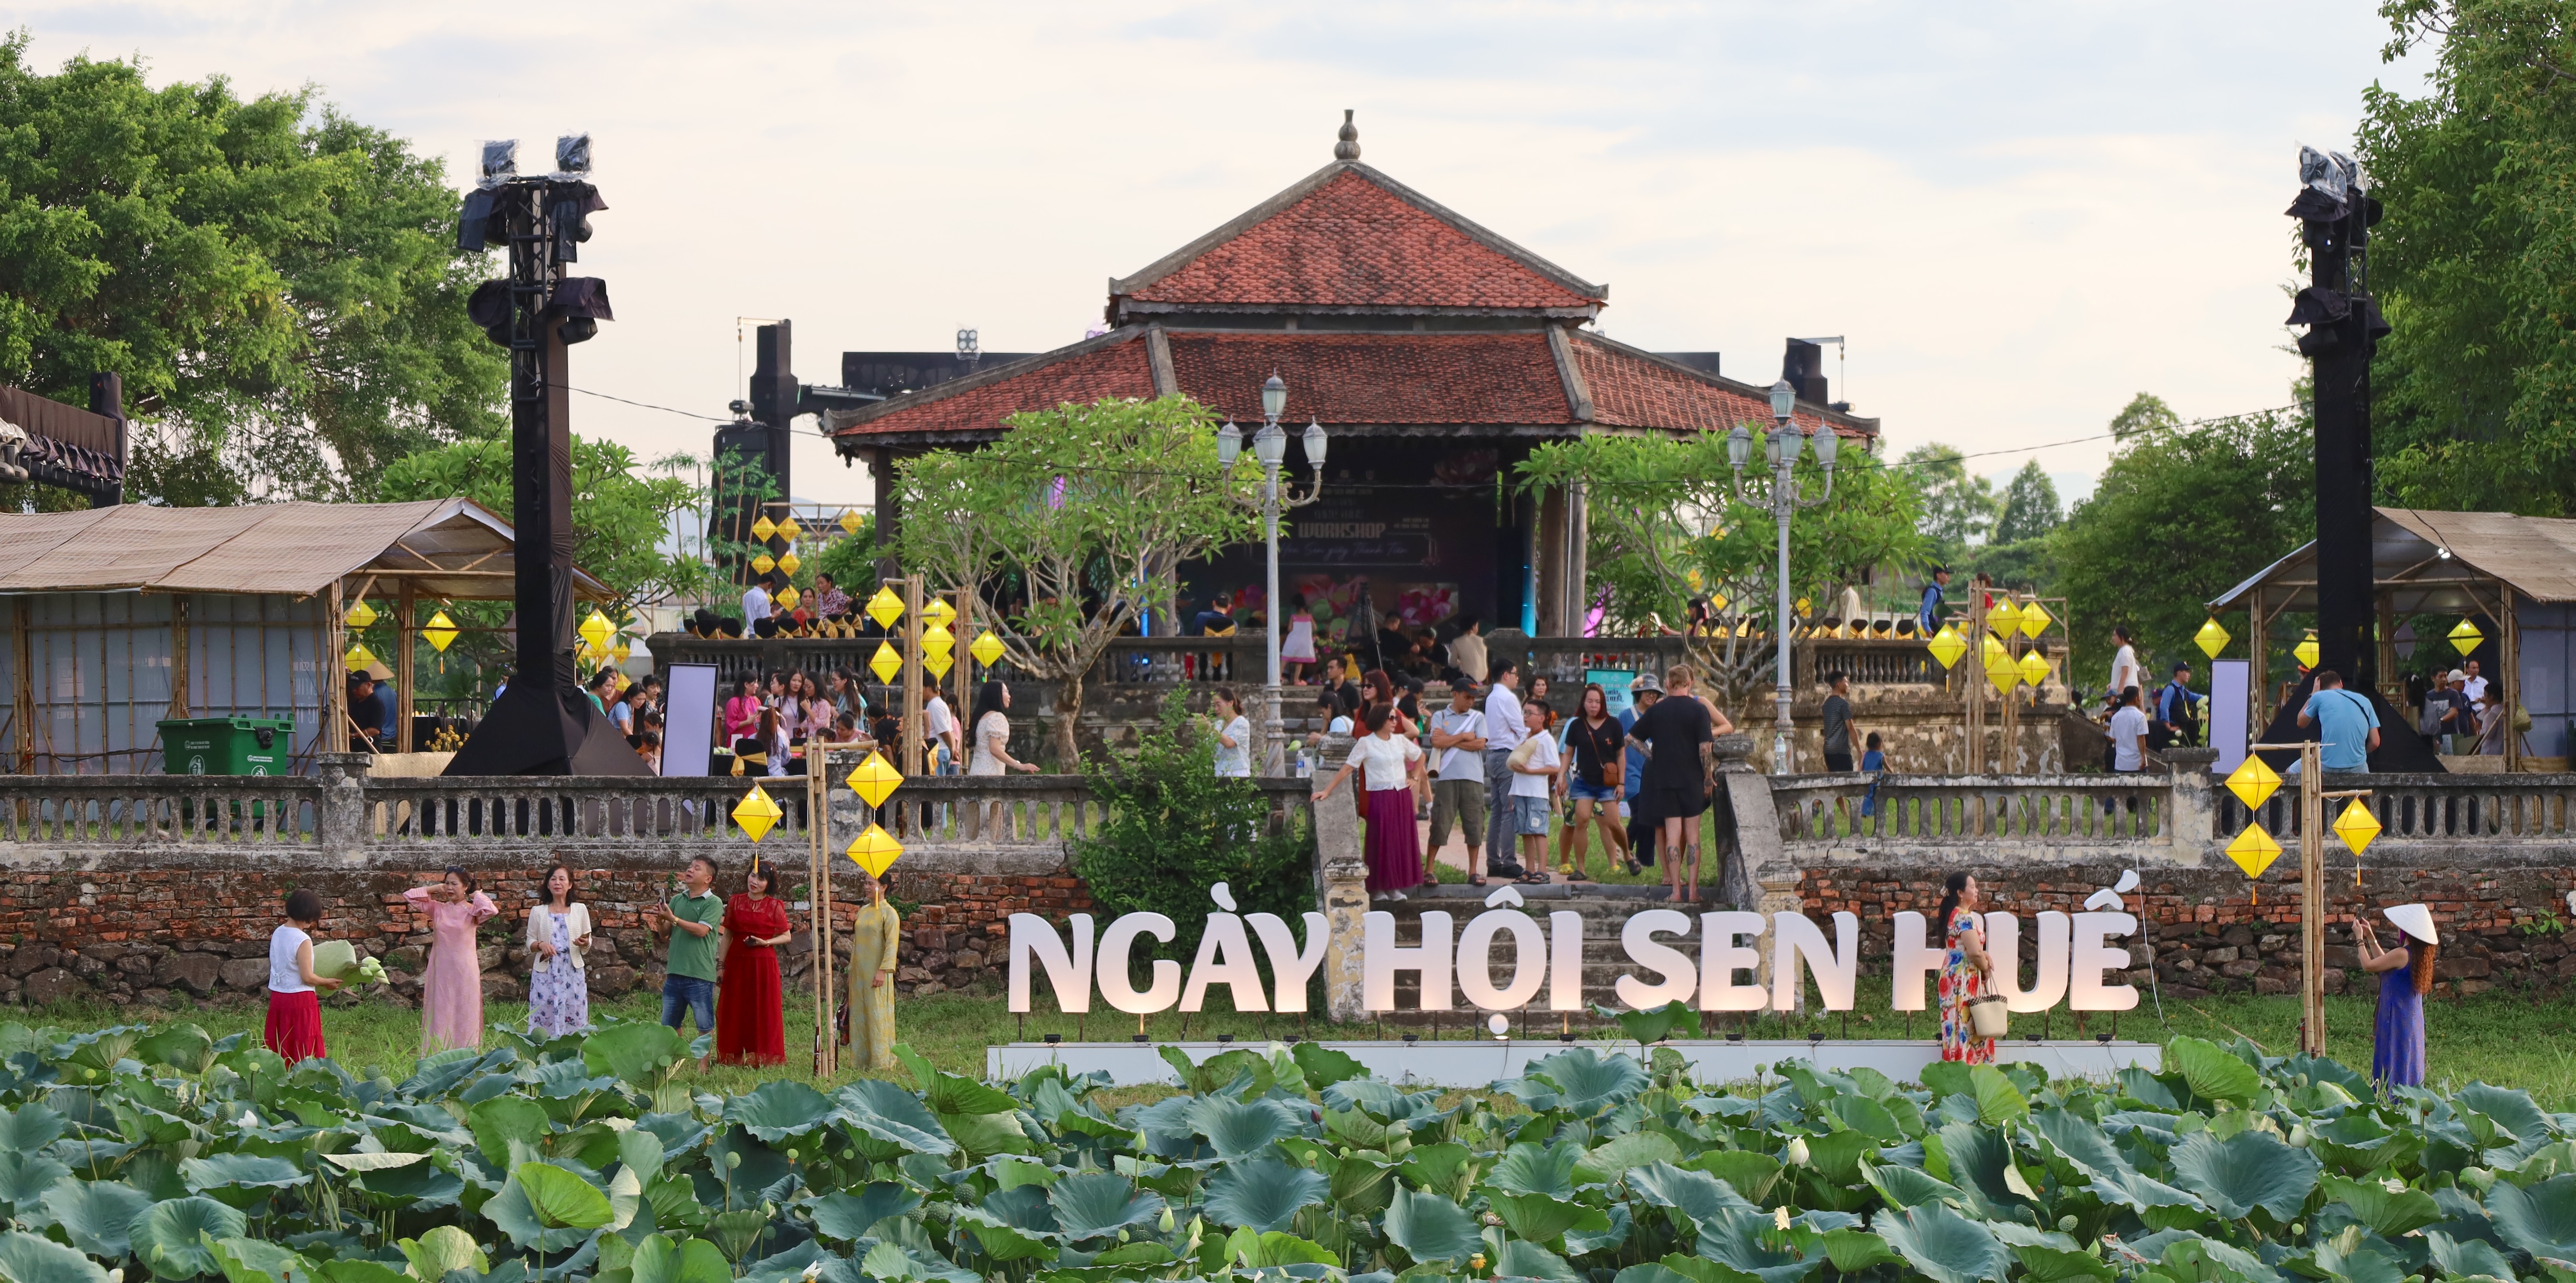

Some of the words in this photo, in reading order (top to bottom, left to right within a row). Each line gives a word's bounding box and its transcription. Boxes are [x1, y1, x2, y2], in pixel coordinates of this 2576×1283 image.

[1299, 523, 1386, 538] WORKSHOP
[1008, 881, 1330, 1014] NGÀY
[1362, 885, 1583, 1035] HỘI
[1614, 909, 1859, 1011] SEN
